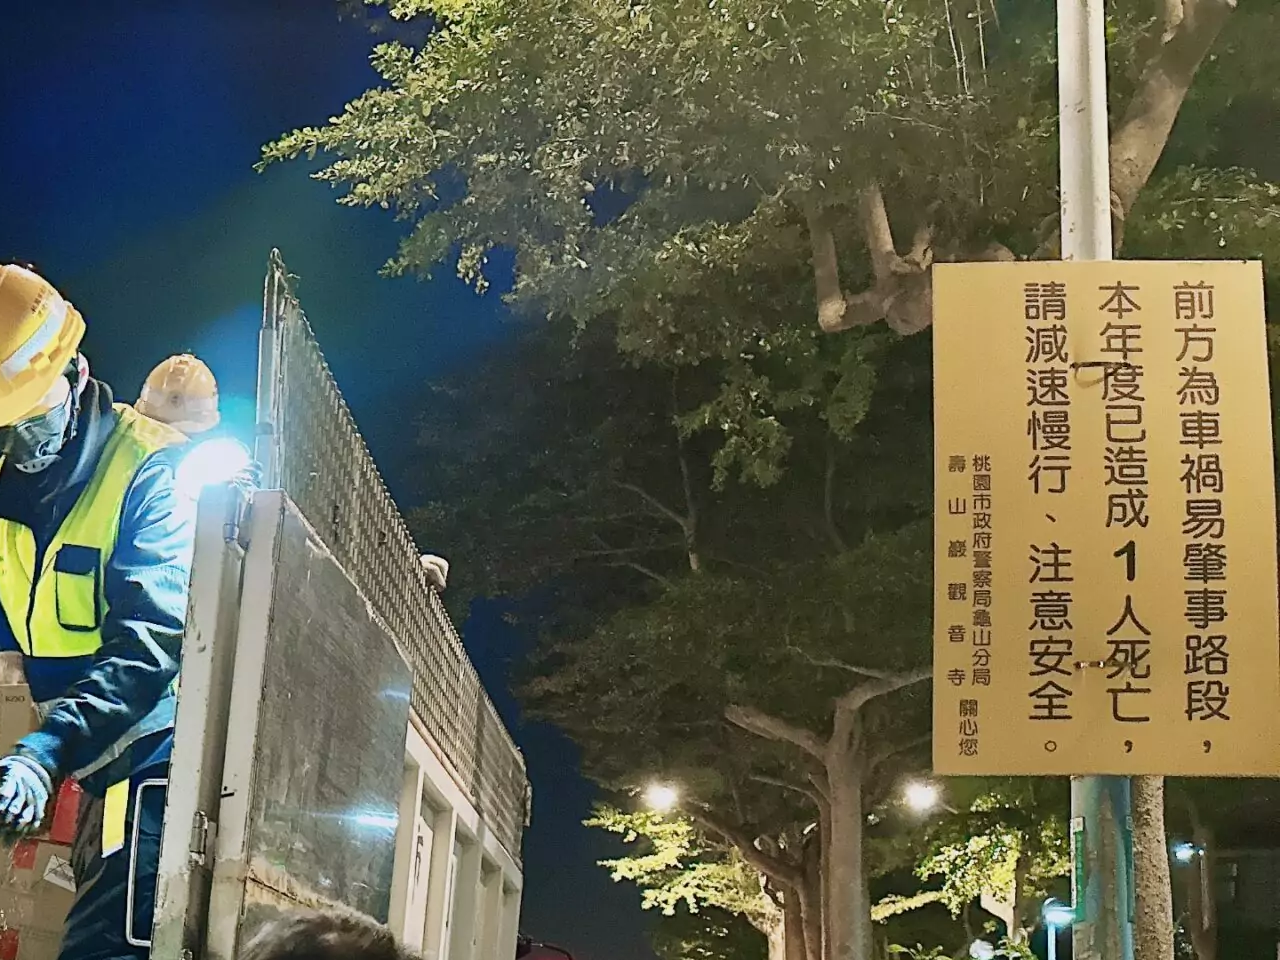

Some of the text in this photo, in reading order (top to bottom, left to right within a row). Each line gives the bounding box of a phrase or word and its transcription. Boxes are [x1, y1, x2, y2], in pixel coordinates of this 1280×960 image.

[972, 454, 993, 686] 桃園市政府警察局龜山分局
[959, 699, 978, 756] 關心您
